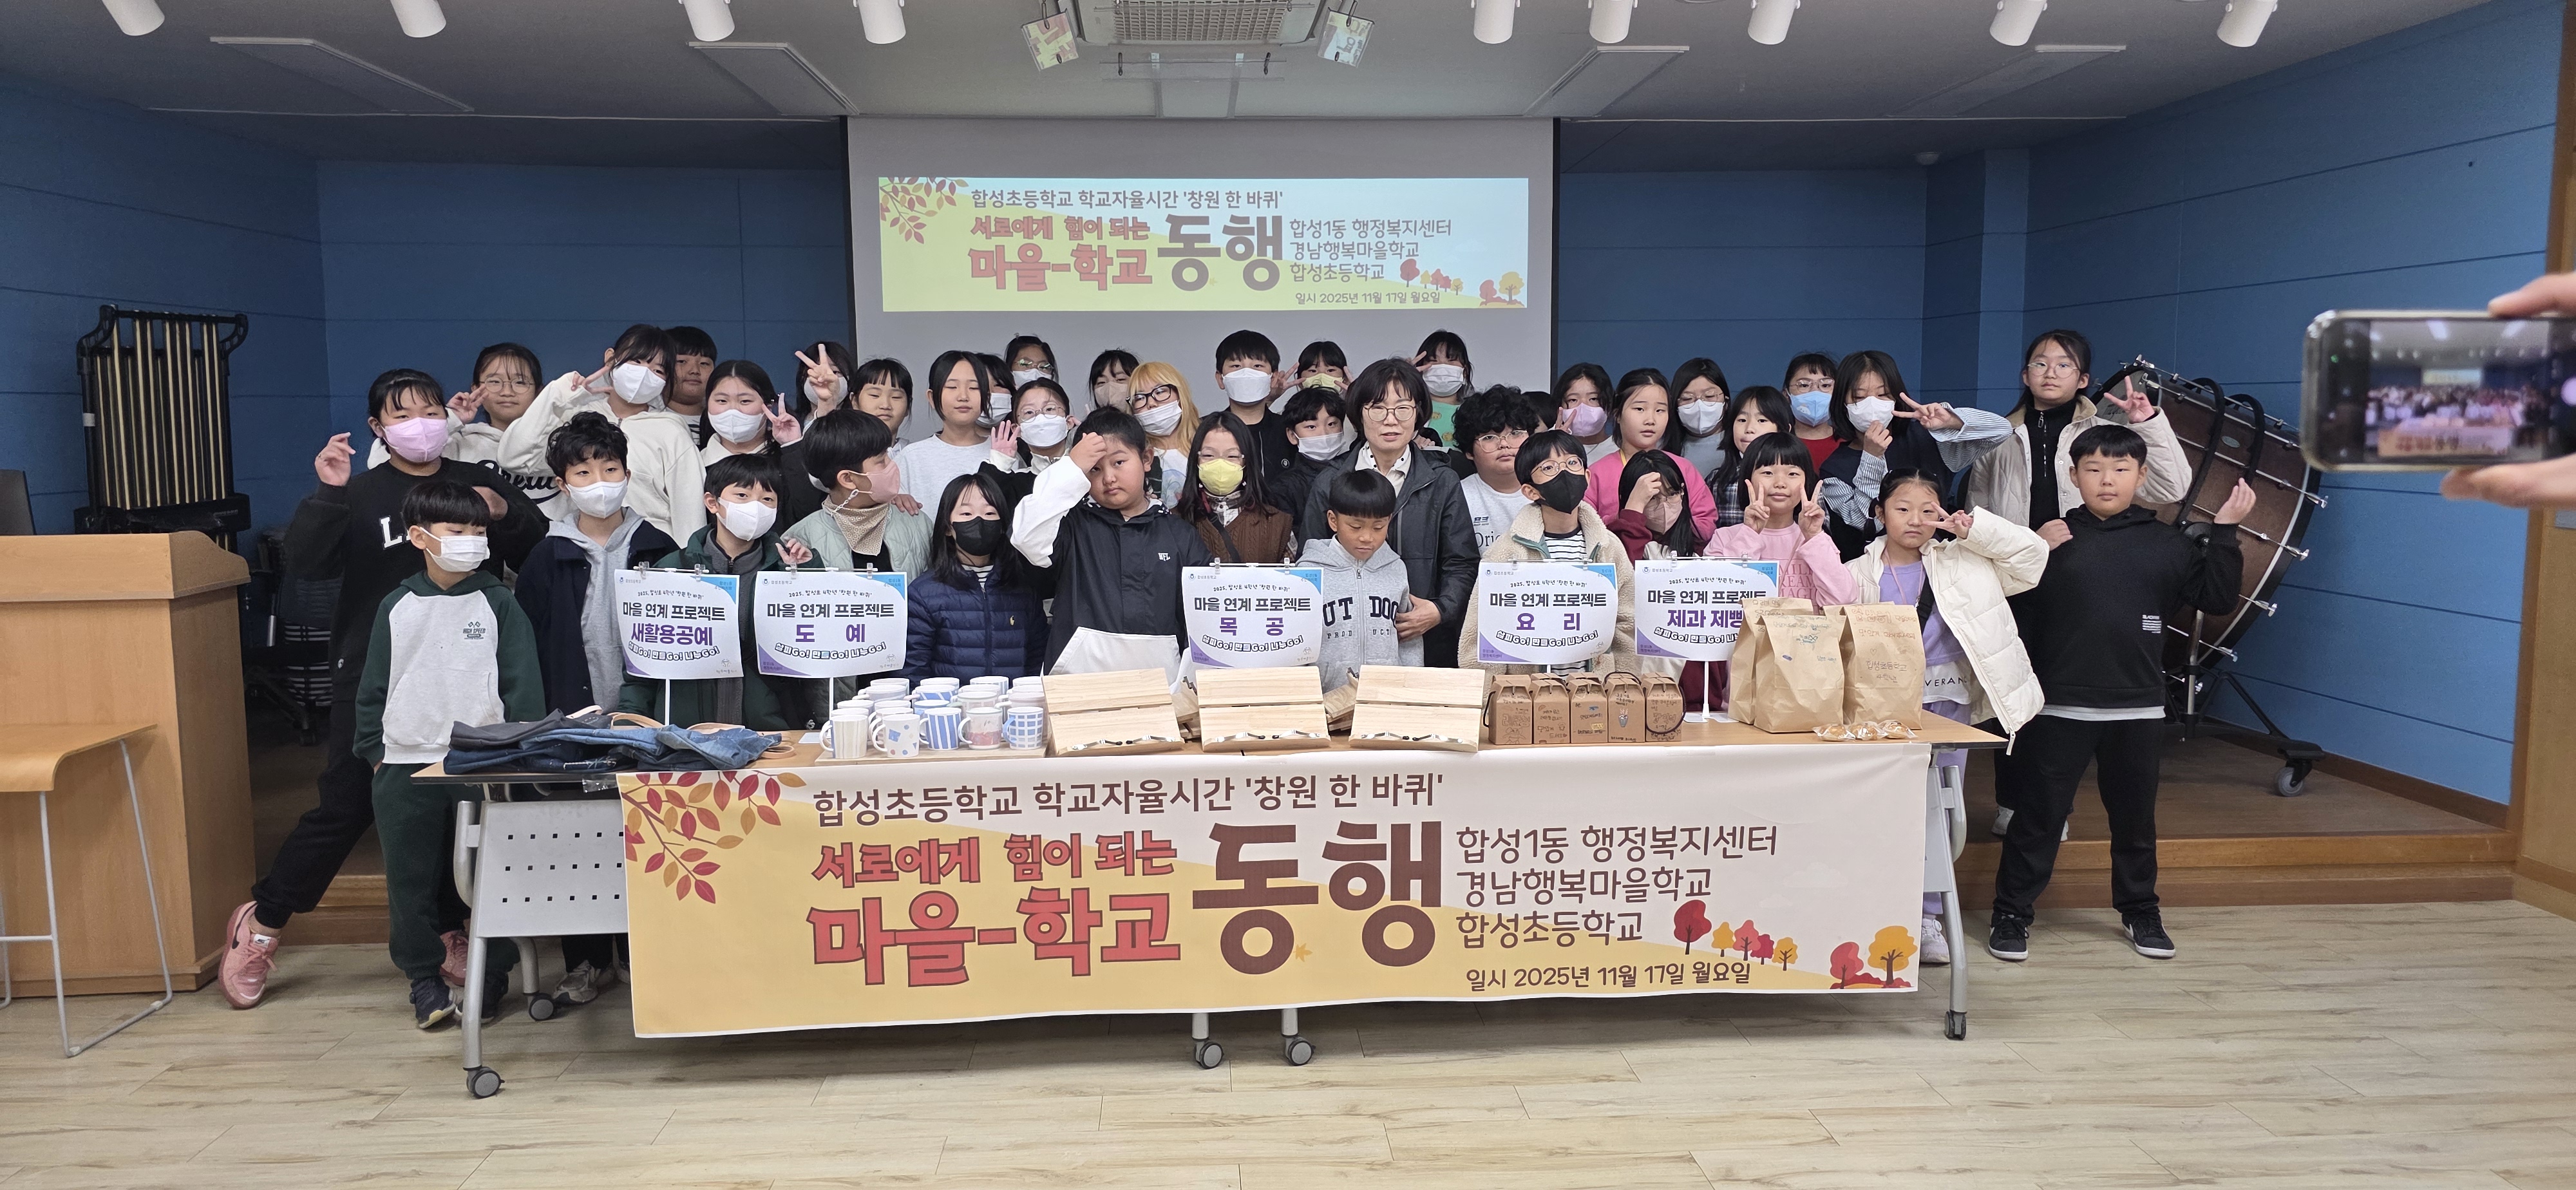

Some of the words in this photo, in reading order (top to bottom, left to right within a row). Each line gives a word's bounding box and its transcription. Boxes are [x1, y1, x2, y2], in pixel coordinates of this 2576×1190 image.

[971, 189, 1074, 209] 합성초등학교
[1078, 190, 1179, 209] 학교자율시간
[1184, 191, 1220, 209] '창원
[1225, 191, 1242, 209] 한
[1247, 191, 1282, 209] 바퀴'
[971, 215, 1054, 240] 서로에게
[1063, 215, 1103, 241] 힘이
[1108, 216, 1151, 240] 되는
[1289, 218, 1347, 239] 합성1동
[1352, 218, 1451, 239] 행정복지센터
[1157, 214, 1283, 291] 동행
[1289, 240, 1419, 260] 경남행복마을학교
[967, 242, 1153, 292] 마을-학교
[1289, 262, 1385, 283] 합성초등학교
[1295, 292, 1316, 305] 일시
[1320, 292, 1358, 304] 2025년
[1361, 292, 1382, 304] 11월
[1385, 292, 1407, 303] 17일
[1410, 291, 1441, 303] 월요일
[380, 516, 411, 549] L
[1194, 597, 1220, 612] 마을
[1224, 598, 1251, 612] 연계
[1255, 598, 1311, 612] 프로젝트
[1490, 593, 1517, 607] 마을
[1520, 593, 1549, 607] 연계
[1553, 593, 1607, 607] 프로젝트
[1647, 590, 1676, 604] 마을
[1680, 590, 1708, 604] 연계
[623, 601, 643, 617] 마을
[645, 603, 668, 619] 연계
[671, 605, 726, 621] 프로젝트
[767, 603, 796, 618] 마을
[800, 604, 830, 618] 연계
[834, 604, 895, 618] 프로젝트
[1667, 610, 1707, 628] 제과
[1219, 617, 1238, 636] 목
[1265, 617, 1284, 636] 공
[1516, 612, 1535, 630] 요
[1564, 612, 1580, 631] 리
[631, 623, 713, 646] 새활용공예
[795, 624, 815, 643] 도
[846, 623, 866, 643] 예
[813, 784, 1023, 827] 합성초등학교
[1032, 777, 1235, 817] 학교자율시간
[1246, 775, 1316, 810] '창원
[1329, 774, 1361, 808] 한
[1372, 773, 1443, 807] 바퀴'
[1456, 826, 1569, 864] 합성1동
[1581, 825, 1777, 863] 행정복지센터
[811, 836, 981, 888] 서로에게
[1003, 832, 1082, 882] 힘이
[1094, 829, 1177, 877] 되는
[1456, 865, 1712, 908] 경남행복마을학교
[1193, 820, 1442, 975] 동행
[806, 885, 1181, 987] 마을-학교
[1456, 909, 1643, 949] 합성초등학교
[1466, 968, 1508, 992] 일시
[1513, 965, 1590, 988] 2025년
[1597, 964, 1638, 988] 11월
[1644, 963, 1685, 986] 17일
[1692, 961, 1751, 985] 월요일
